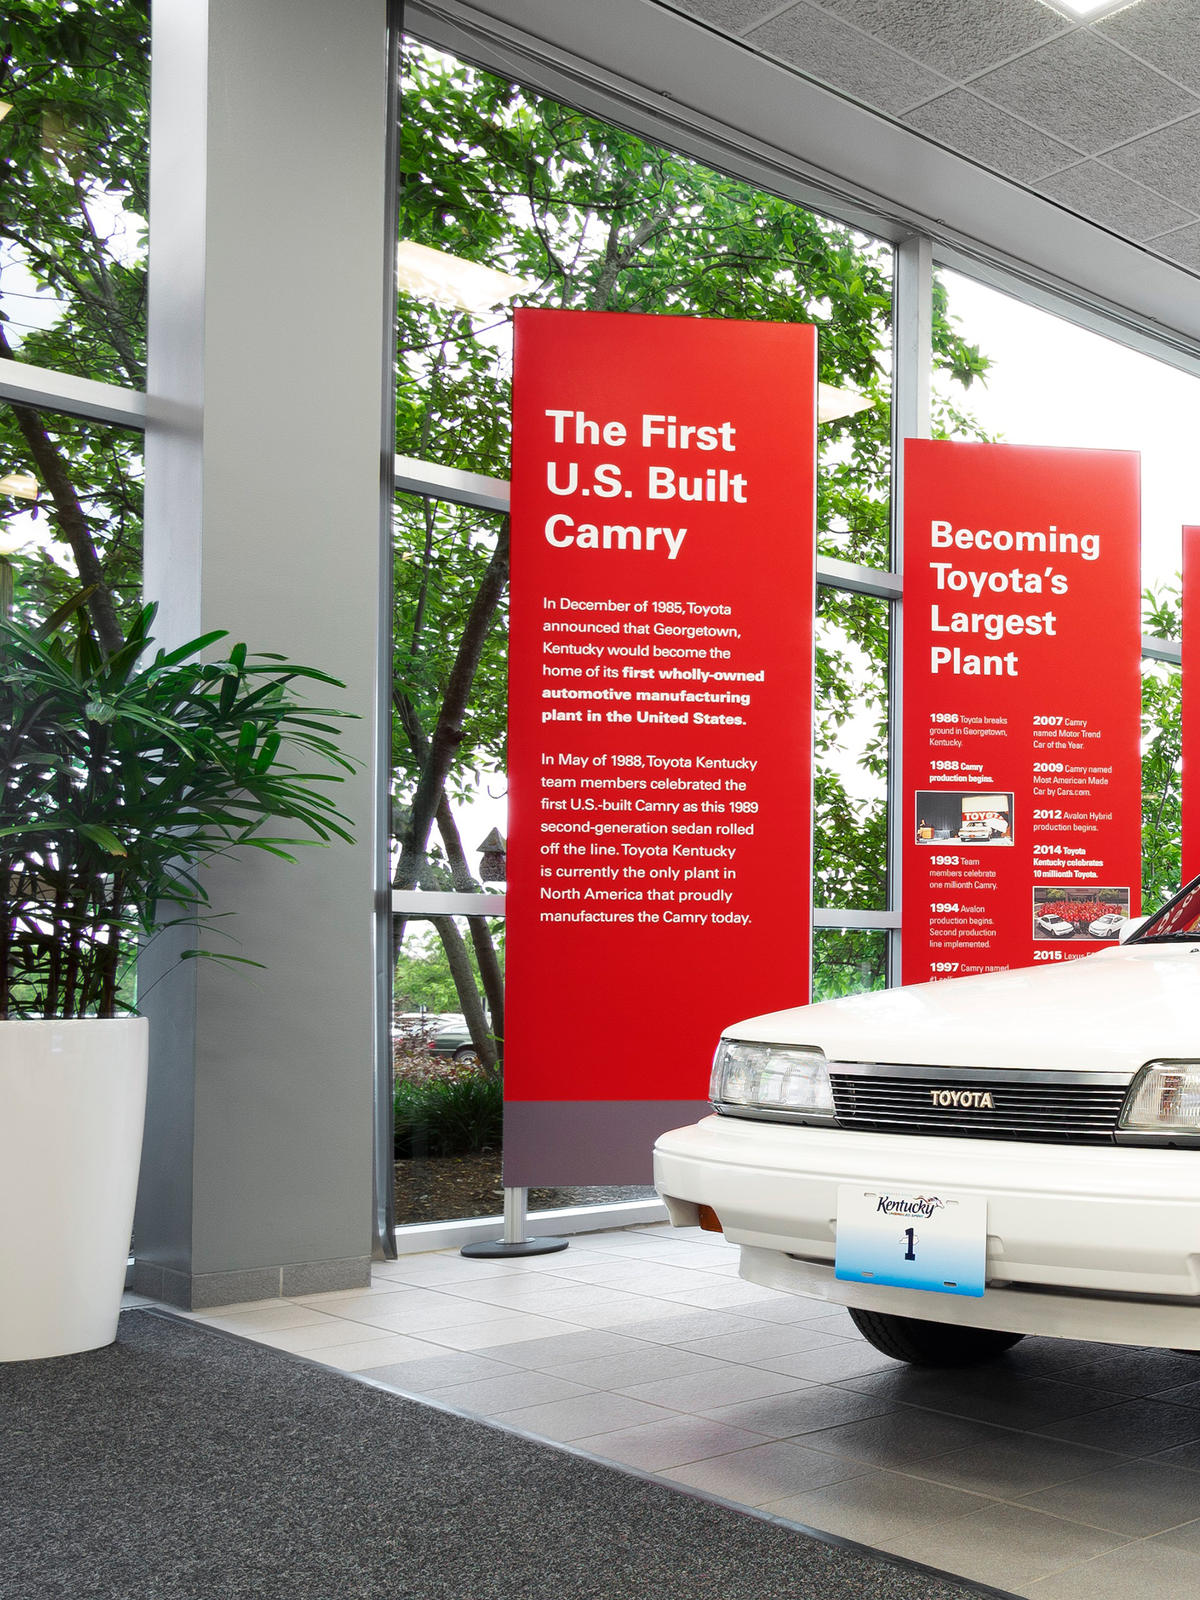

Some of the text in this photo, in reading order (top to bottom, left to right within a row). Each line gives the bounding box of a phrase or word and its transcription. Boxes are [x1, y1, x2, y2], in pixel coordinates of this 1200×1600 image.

[545, 410, 736, 451] The First
[546, 462, 747, 503] U.S. Built
[544, 514, 688, 560] Camry
[931, 520, 1100, 560] Becoming
[929, 562, 1068, 598] Toyota's
[544, 597, 731, 617] In December of 1985, Toyota
[931, 604, 1056, 640] Largest
[543, 623, 741, 639] announced that Georgetown,
[544, 642, 731, 659] Kentucky would become the
[931, 646, 1018, 676] Plant
[543, 664, 765, 683] home of its first wholly-owned
[542, 688, 750, 706] automotive manufacturing
[542, 709, 746, 725] plant in the United States.
[930, 713, 1008, 724] 1986 Toyota breaks
[1033, 716, 1087, 728] 2007 Camry
[542, 753, 758, 772] In May of 1988, Toyota Kentucky
[930, 760, 983, 772] 1988 Camry
[1033, 763, 1064, 772] 2009
[1065, 765, 1087, 774] Camry
[541, 777, 746, 791] team members celebrated the
[930, 774, 994, 784] production begins.
[541, 798, 759, 814] first U.S.-built Camry as this 1989
[1033, 810, 1062, 819] 2012
[1090, 813, 1112, 821] Hybrid
[541, 821, 754, 835] second-generation sedan rolled
[1033, 823, 1098, 832] production begins.
[541, 843, 736, 860] off the line. Toyota Kentucky
[1033, 845, 1086, 856] 2014 Toyota
[930, 856, 959, 865] 1993
[541, 865, 736, 881] is currently the only plant in
[541, 888, 733, 904] North America that proudly
[930, 903, 985, 913] 1994 Avalon
[541, 910, 752, 926] manufactures the Camry today.
[930, 917, 994, 926] production begins.
[930, 928, 996, 938] Second production
[1034, 950, 1062, 960] 2015
[930, 962, 959, 972] 1997
[961, 964, 984, 973] Camry
[930, 1090, 995, 1108] TOYOTA
[877, 1196, 934, 1218] Kentucky
[905, 1228, 915, 1261] 1
